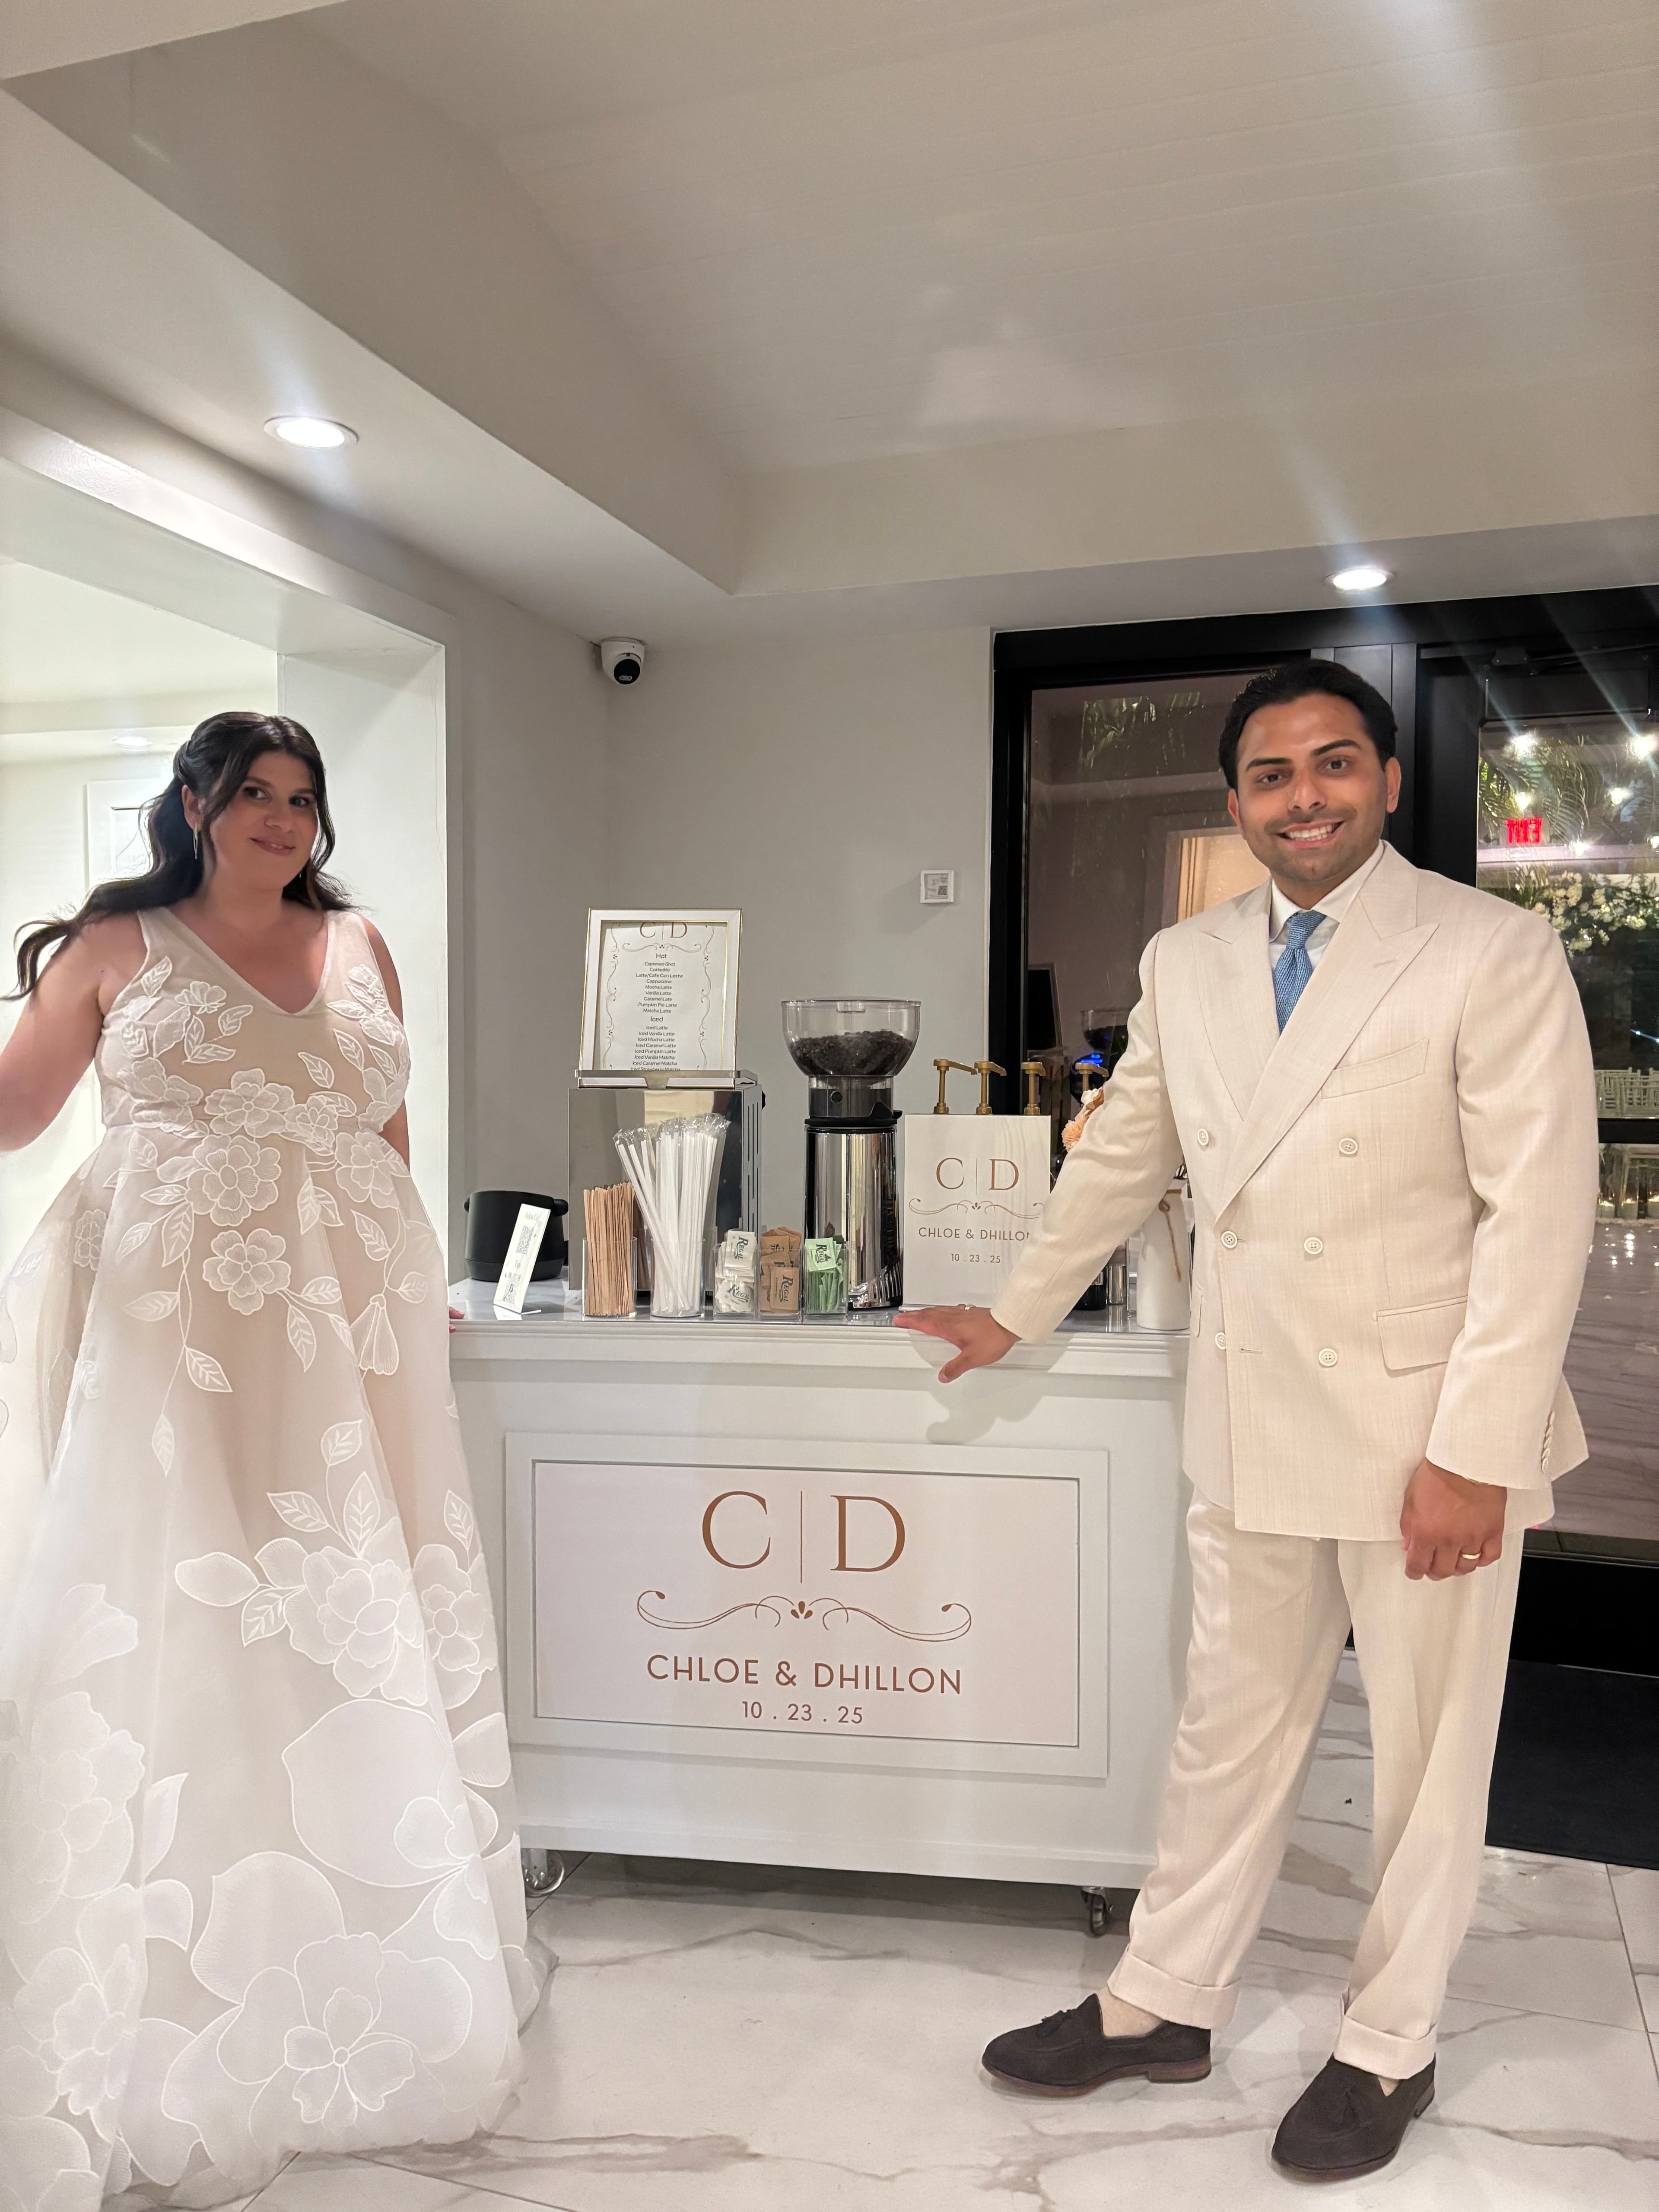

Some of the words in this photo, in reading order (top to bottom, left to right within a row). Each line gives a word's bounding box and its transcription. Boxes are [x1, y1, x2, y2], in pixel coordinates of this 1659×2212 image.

[640, 922, 656, 938] C
[670, 922, 687, 938] D
[937, 1158, 964, 1189] C
[988, 1159, 1019, 1190] D
[919, 1227, 960, 1238] CHLOE
[966, 1229, 974, 1239] &
[734, 1236, 749, 1259] REGAL
[816, 1244, 827, 1263] REGAL
[727, 1284, 750, 1303] REGAL
[780, 1275, 794, 1303] REGAL
[702, 1491, 770, 1569] C
[830, 1495, 905, 1572] D
[648, 1655, 758, 1684] CHLOE
[776, 1661, 796, 1686] &
[815, 1663, 960, 1694] DHILLON
[742, 1701, 762, 1718] 10
[788, 1703, 811, 1721] 23
[838, 1706, 862, 1723] 25
